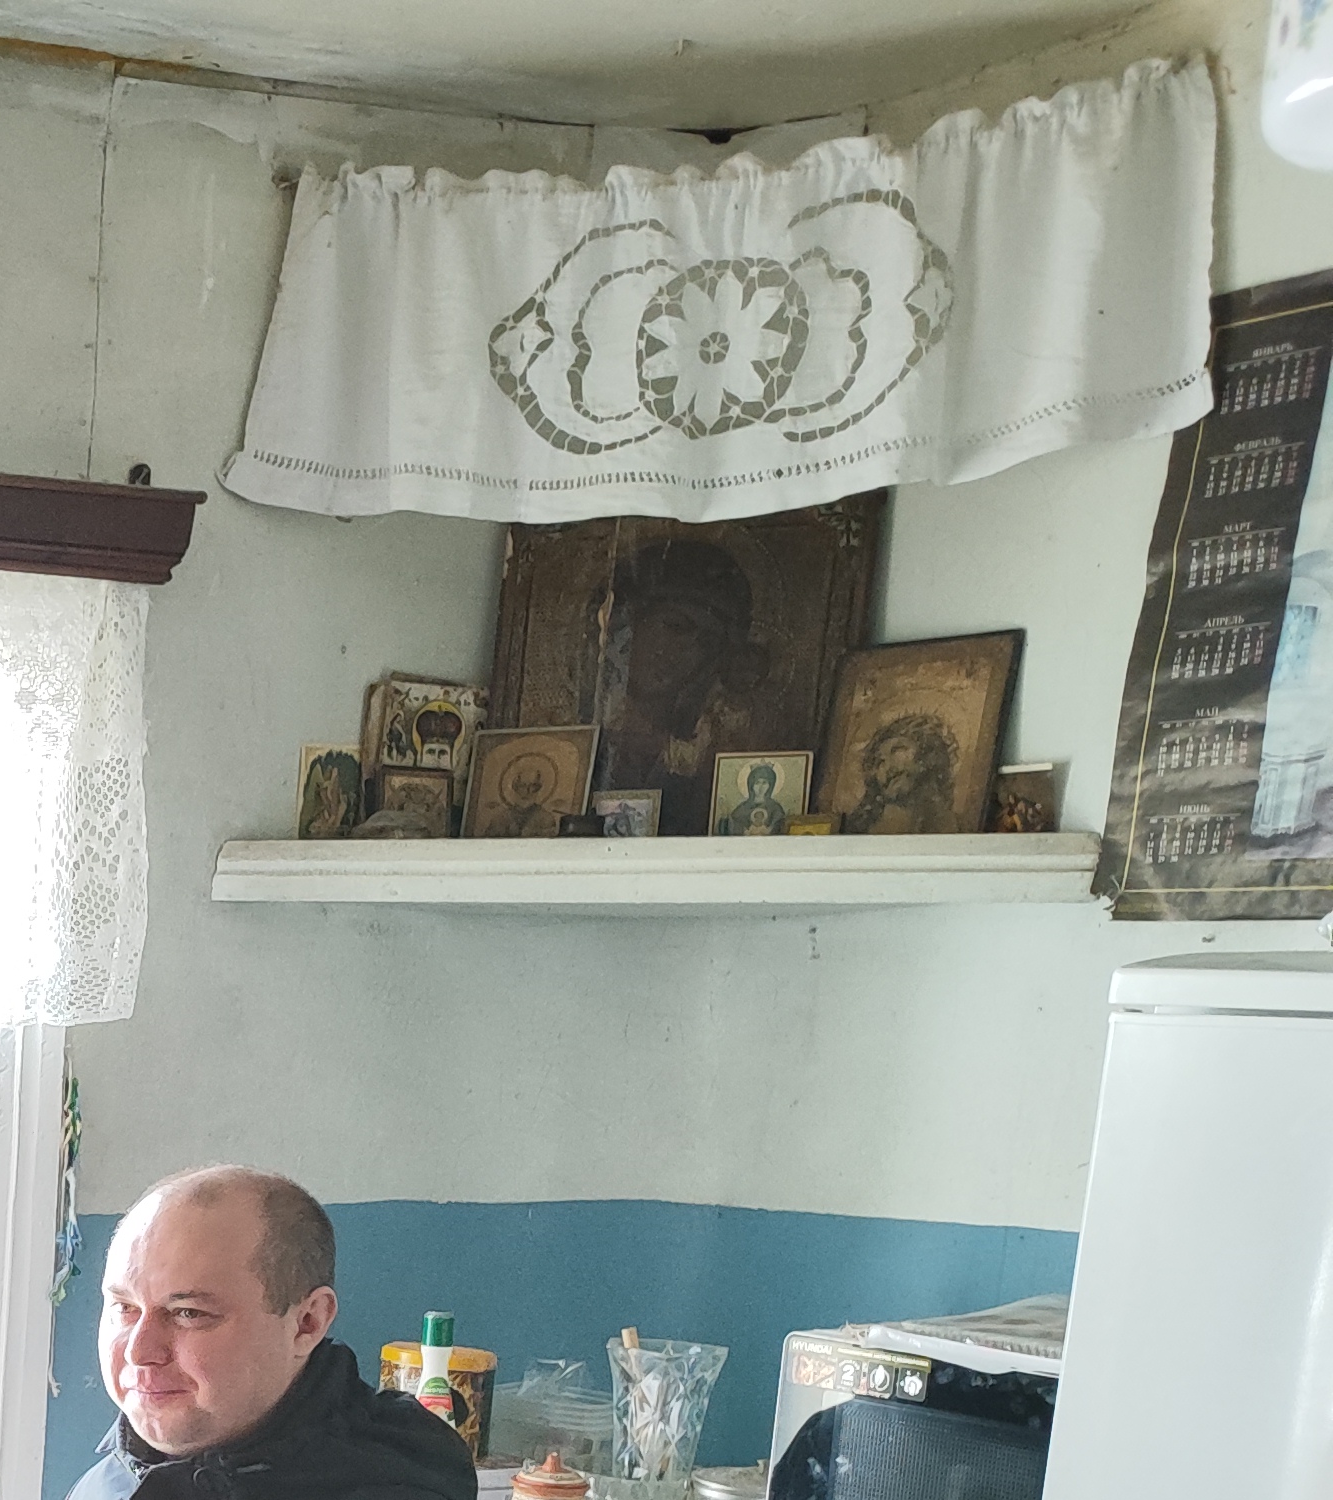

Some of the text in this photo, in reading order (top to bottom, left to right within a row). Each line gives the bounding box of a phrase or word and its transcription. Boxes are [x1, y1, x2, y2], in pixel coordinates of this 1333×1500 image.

[1223, 522, 1253, 533] МАРТ
[1204, 615, 1245, 628] АПРЕЛЬ
[1195, 707, 1219, 717] МАЙ
[792, 1340, 833, 1356] HYUNDAI
[842, 1364, 854, 1381] 2
